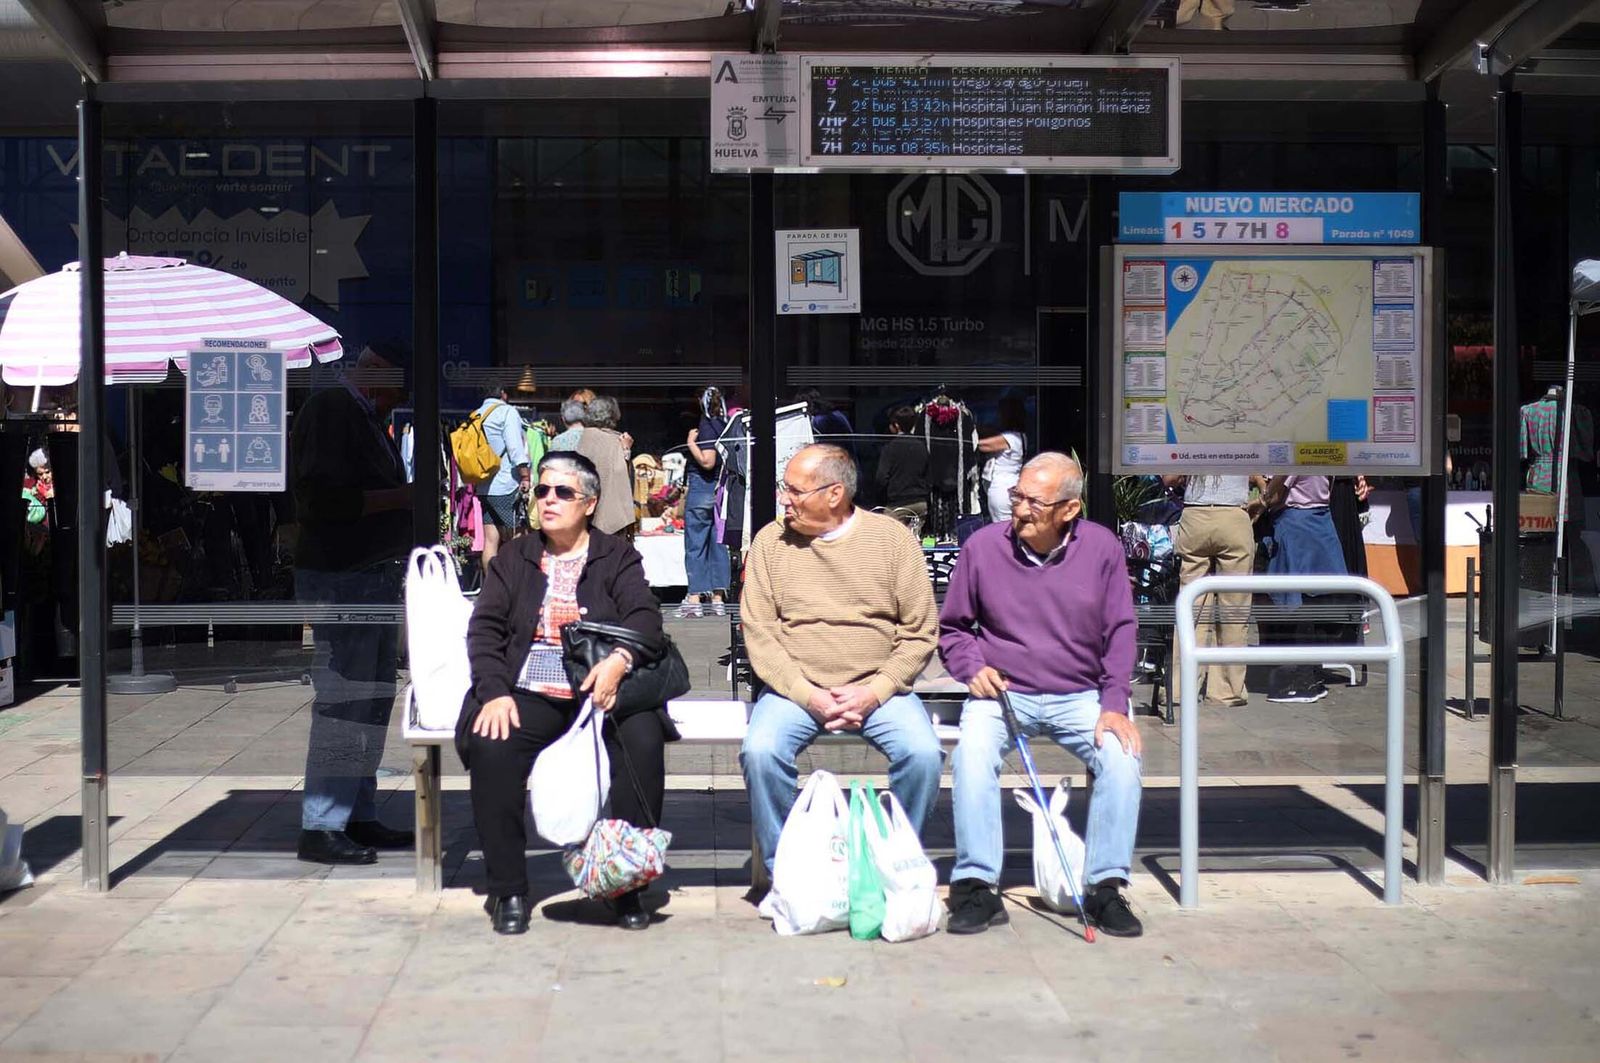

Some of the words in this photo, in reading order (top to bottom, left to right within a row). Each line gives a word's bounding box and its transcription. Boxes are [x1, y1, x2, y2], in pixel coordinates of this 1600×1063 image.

[827, 100, 836, 112] 7
[872, 100, 896, 112] bus
[952, 101, 1007, 116] Hospital
[1010, 101, 1042, 112] Juan
[1046, 100, 1092, 112] Ramón
[1097, 100, 1150, 114] Jiménez
[952, 117, 1024, 129] Hospitales
[715, 149, 758, 158] HUELVA
[822, 142, 842, 154] 7H
[872, 142, 896, 154] bus
[952, 142, 1024, 156] Hospitales
[46, 144, 392, 178] VTALDENT
[1186, 197, 1253, 212] NUEVO
[1260, 197, 1354, 214] MERCADO
[901, 174, 988, 262] MG
[128, 226, 229, 244] Ortodoncia
[1172, 222, 1182, 238] 1
[1194, 222, 1206, 238] 5
[1214, 222, 1228, 238] 7
[1236, 222, 1267, 238] 7H
[1276, 222, 1289, 239] 8
[1332, 230, 1370, 238] Parada
[1388, 230, 1414, 238] 1049
[231, 260, 247, 270] de
[860, 317, 889, 332] MG
[892, 317, 914, 332] HS
[919, 317, 938, 332] 1.5
[941, 317, 984, 332] Turbo
[204, 340, 268, 348] RECOMENDACIONES
